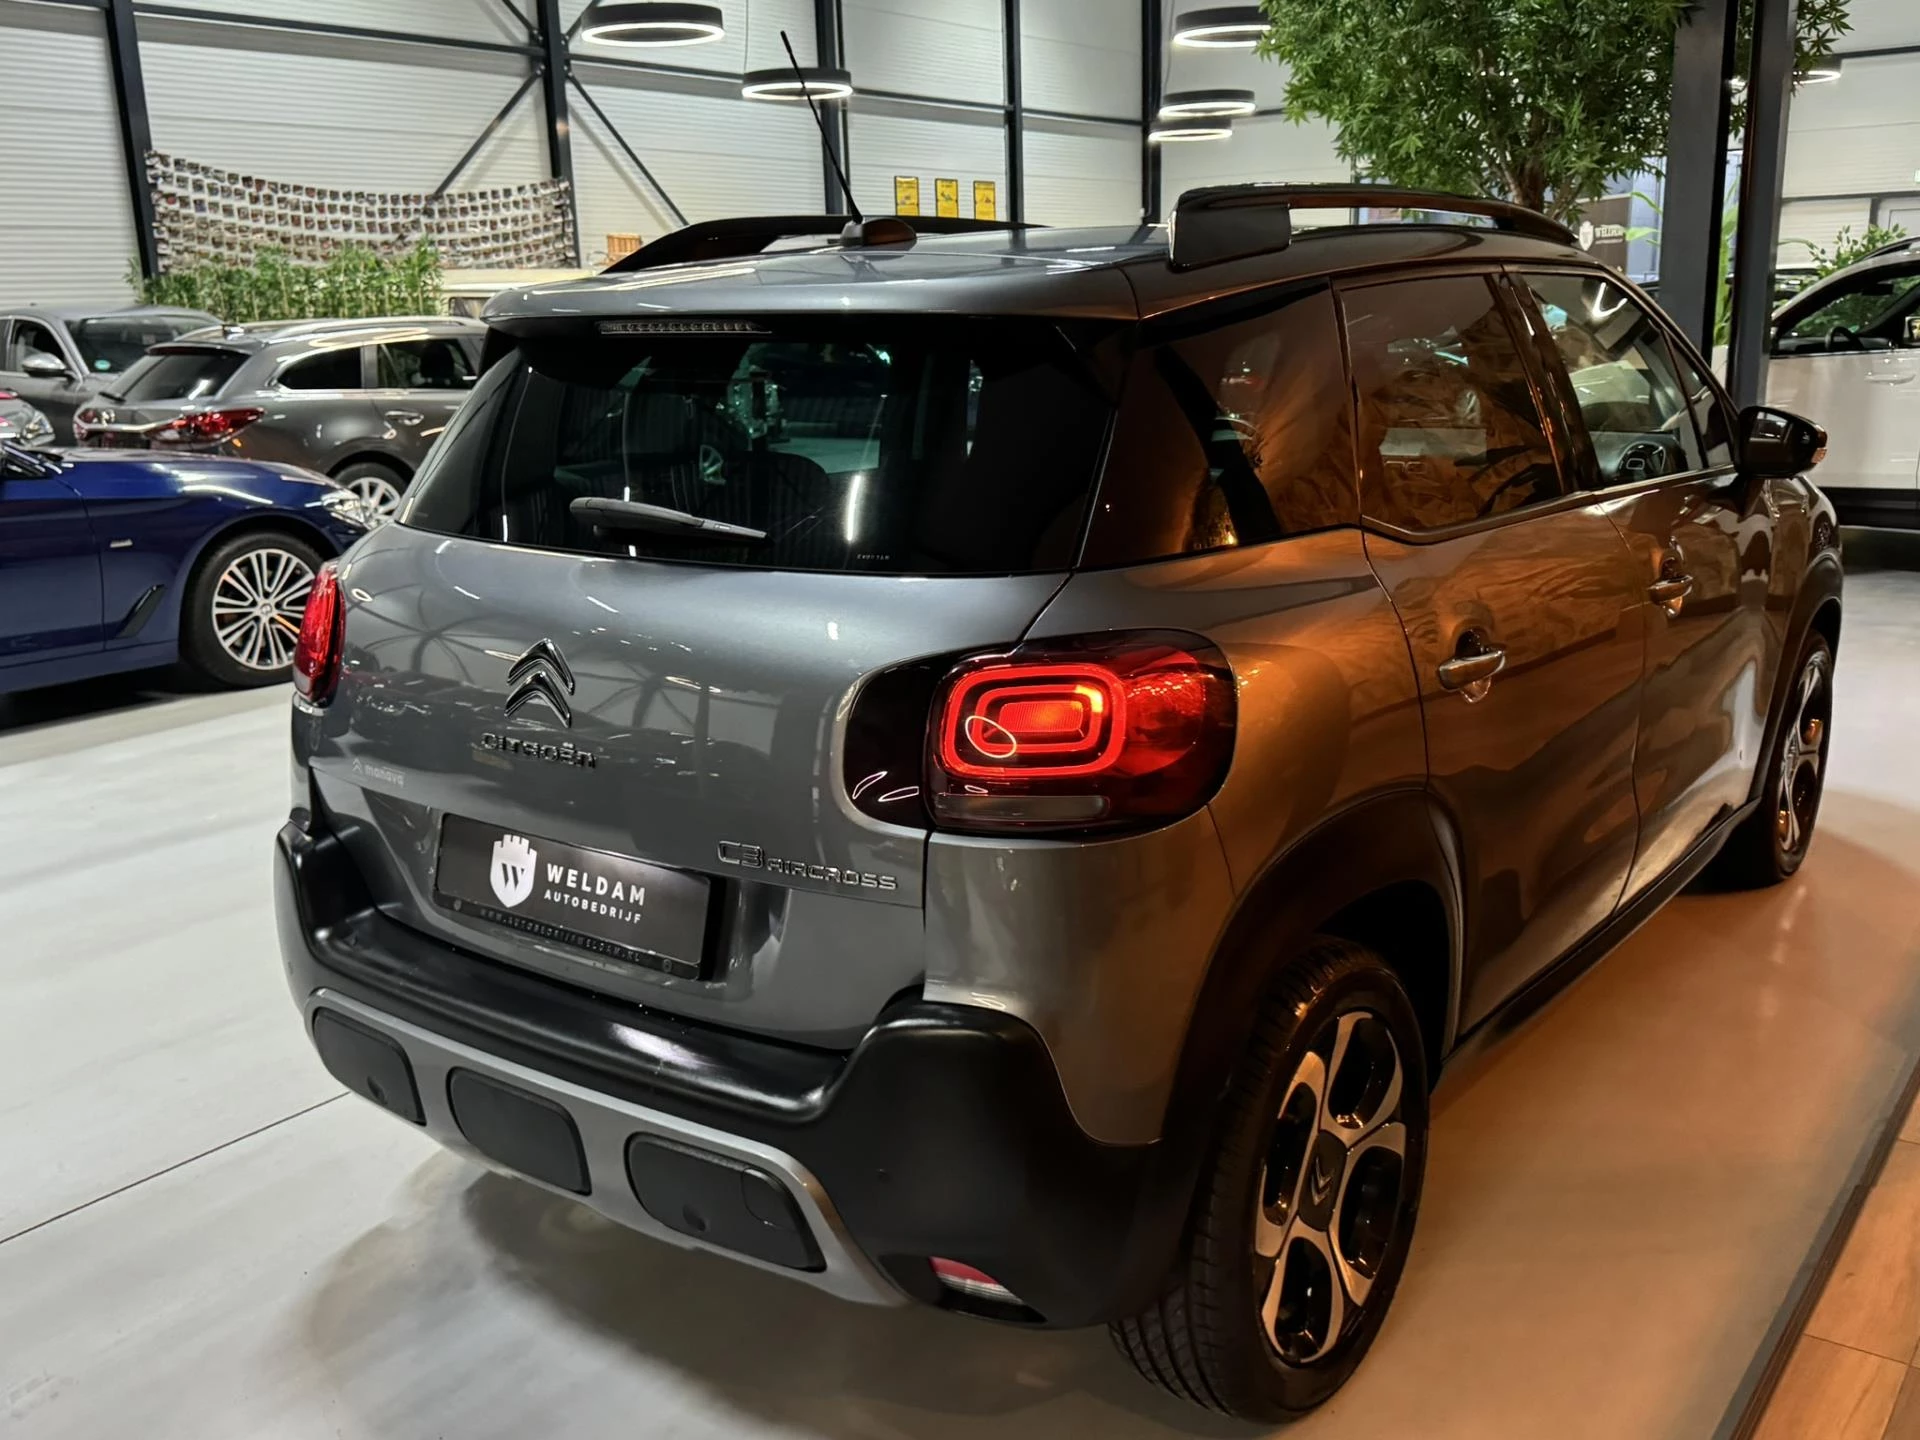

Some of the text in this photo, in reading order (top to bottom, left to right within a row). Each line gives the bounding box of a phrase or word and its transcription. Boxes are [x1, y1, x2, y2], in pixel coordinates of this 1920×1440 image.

[546, 863, 646, 906] WELDAM
[717, 840, 897, 890] C3 AIRCROSS
[544, 889, 643, 924] AUTOBEDRIJF
